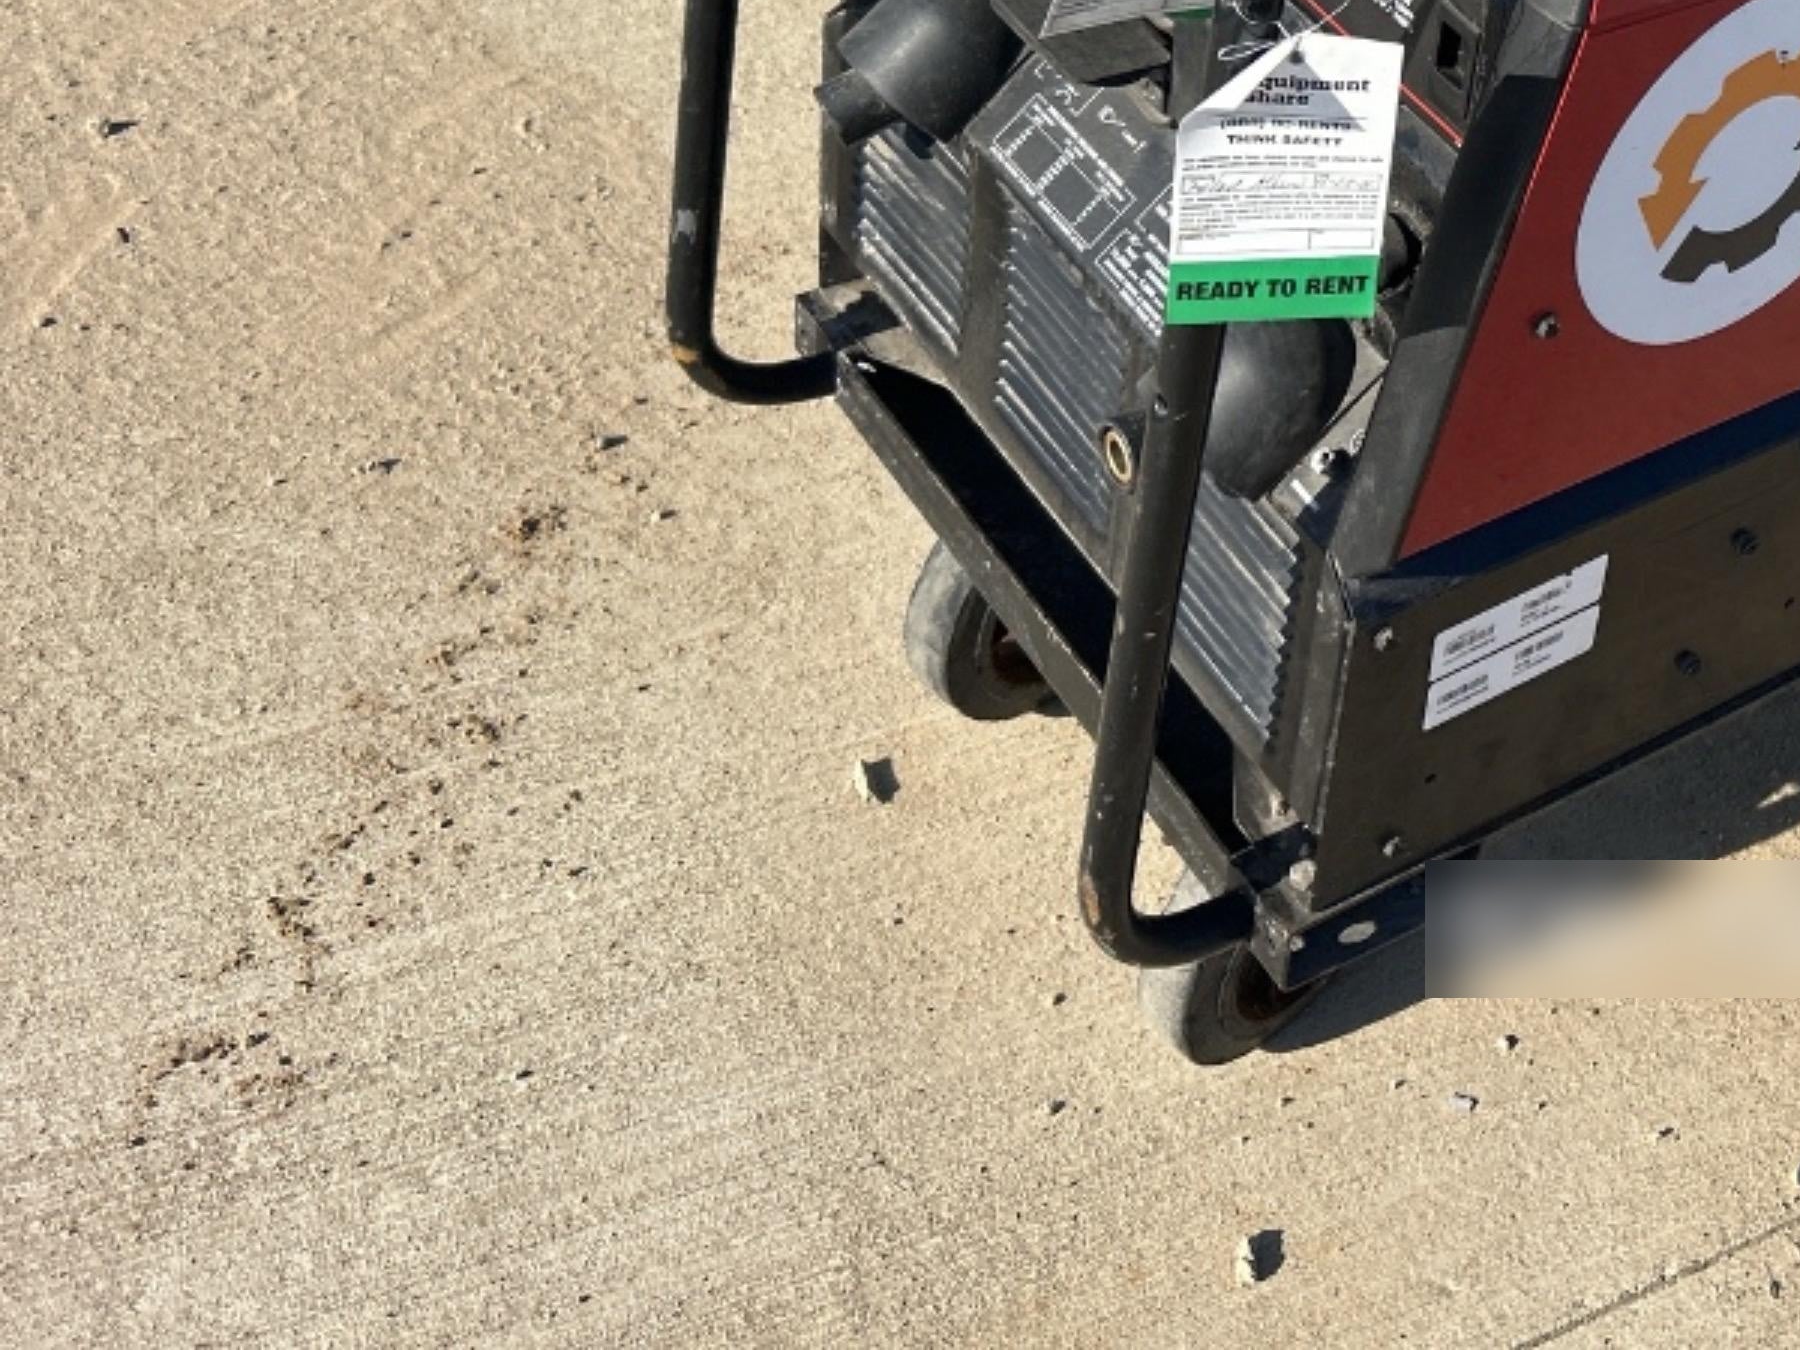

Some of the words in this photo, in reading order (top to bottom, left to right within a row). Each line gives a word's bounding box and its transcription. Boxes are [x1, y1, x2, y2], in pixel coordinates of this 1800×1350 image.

[1257, 74, 1372, 93] quipment
[1226, 134, 1277, 146] THINK
[1281, 134, 1343, 147] SAFETY
[1175, 279, 1260, 301] READY
[1265, 278, 1297, 298] TO
[1304, 274, 1370, 296] RENT
